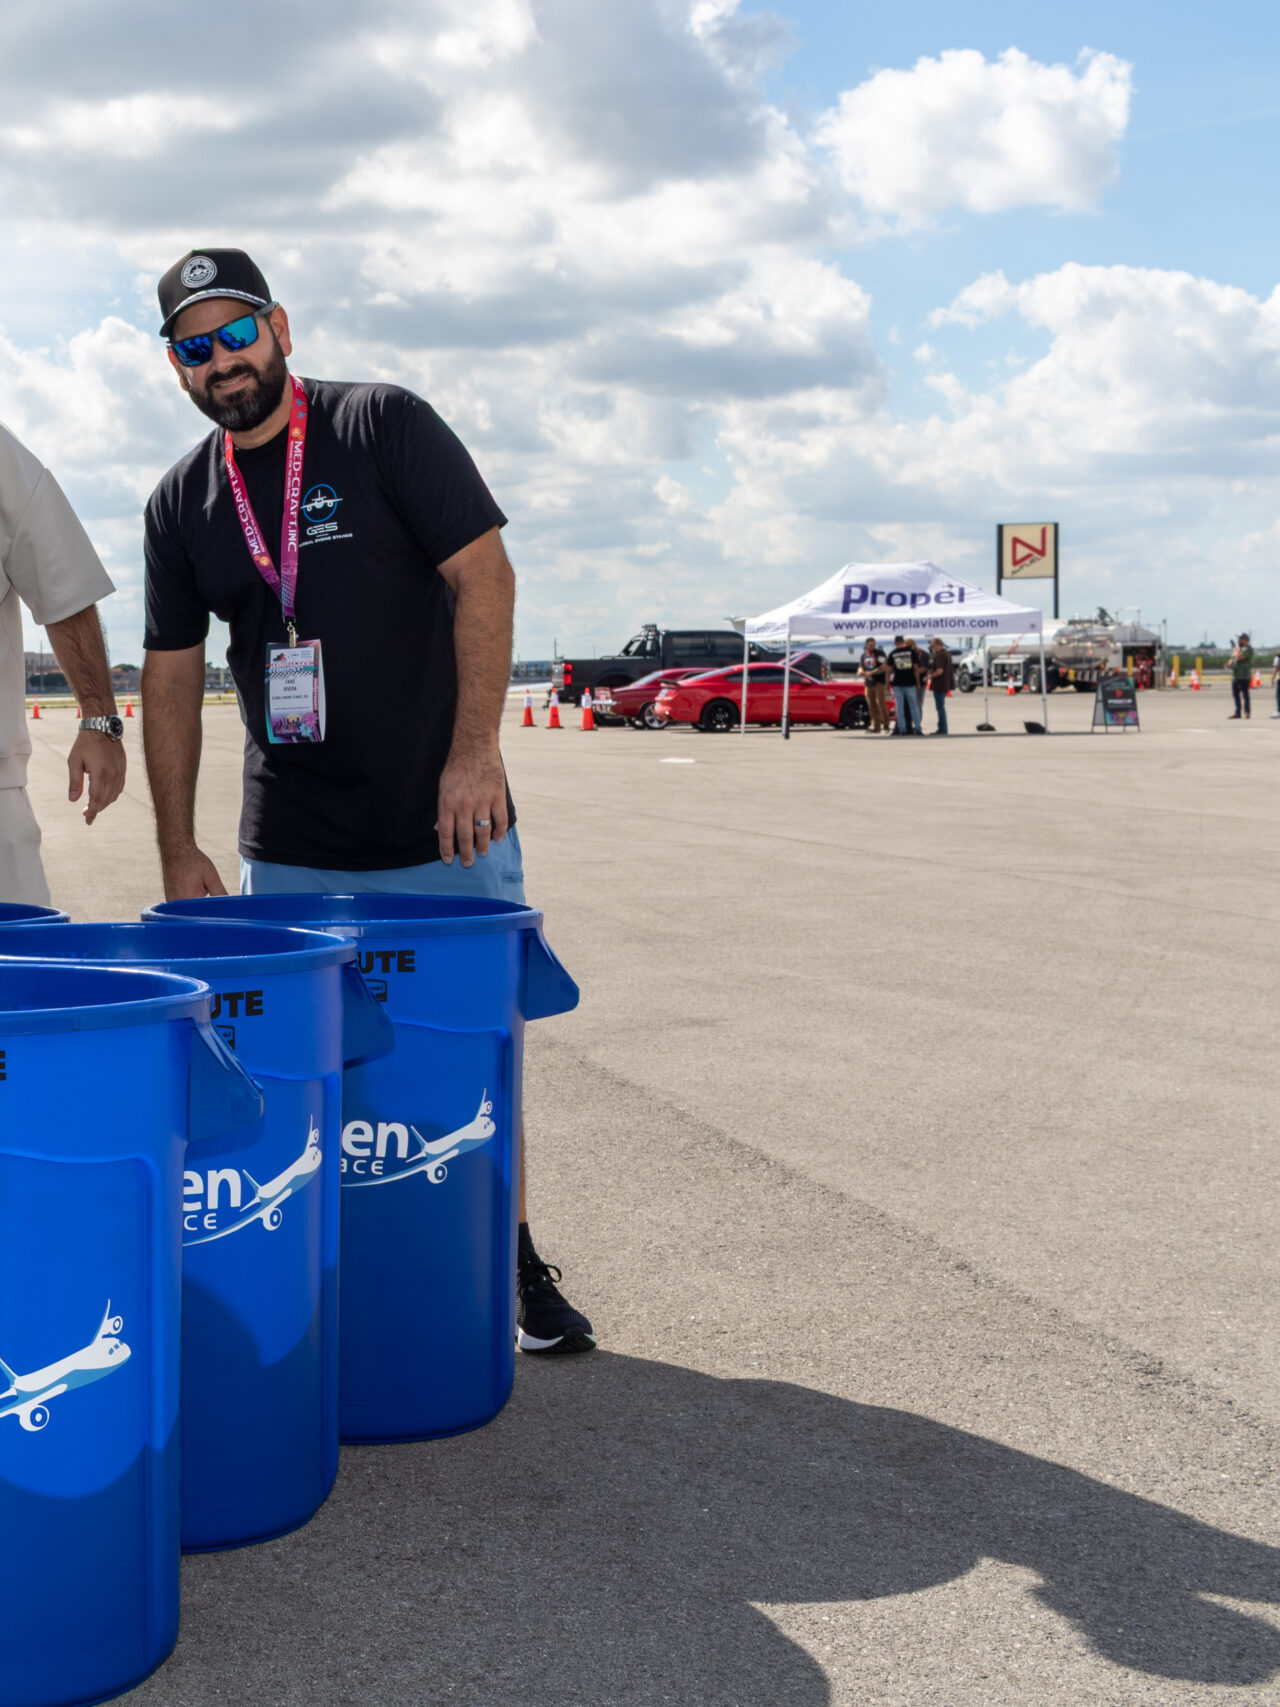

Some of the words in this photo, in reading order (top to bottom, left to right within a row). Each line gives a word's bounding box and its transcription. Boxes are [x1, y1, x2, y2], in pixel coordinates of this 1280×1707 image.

[841, 583, 966, 614] Propel
[833, 617, 999, 631] www.propelaviation.com
[358, 949, 415, 974] UTE
